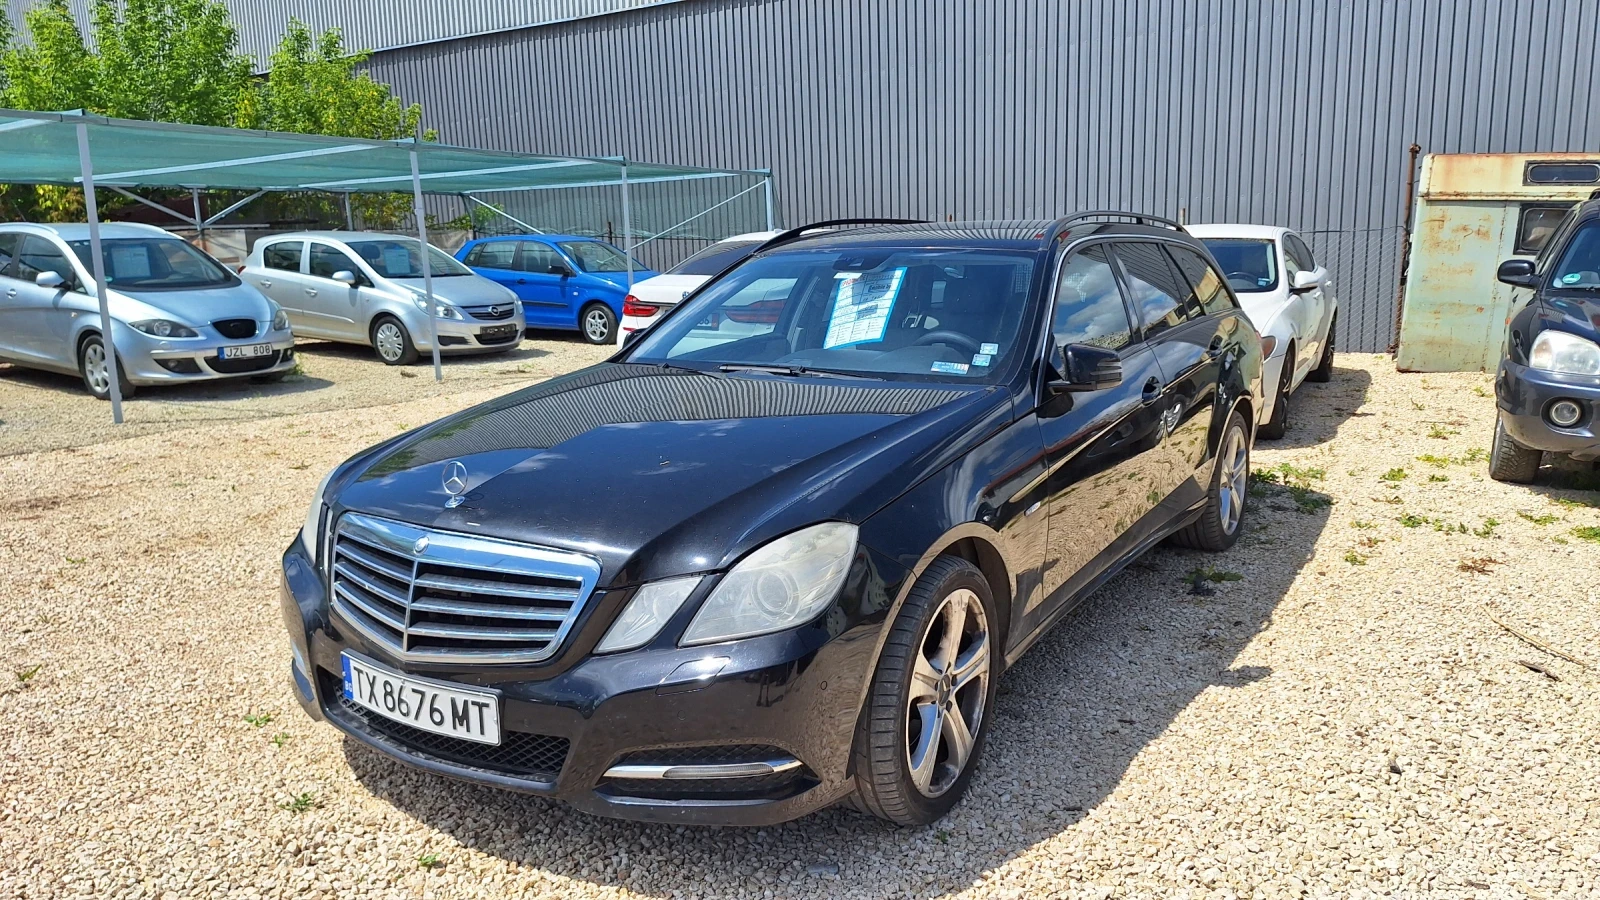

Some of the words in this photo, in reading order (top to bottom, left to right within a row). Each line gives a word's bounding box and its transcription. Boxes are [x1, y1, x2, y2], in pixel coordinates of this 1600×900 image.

[226, 347, 247, 357] JZL
[253, 345, 270, 355] 808
[353, 666, 379, 708] TX
[383, 680, 445, 726] 8676
[451, 697, 490, 735] MT
